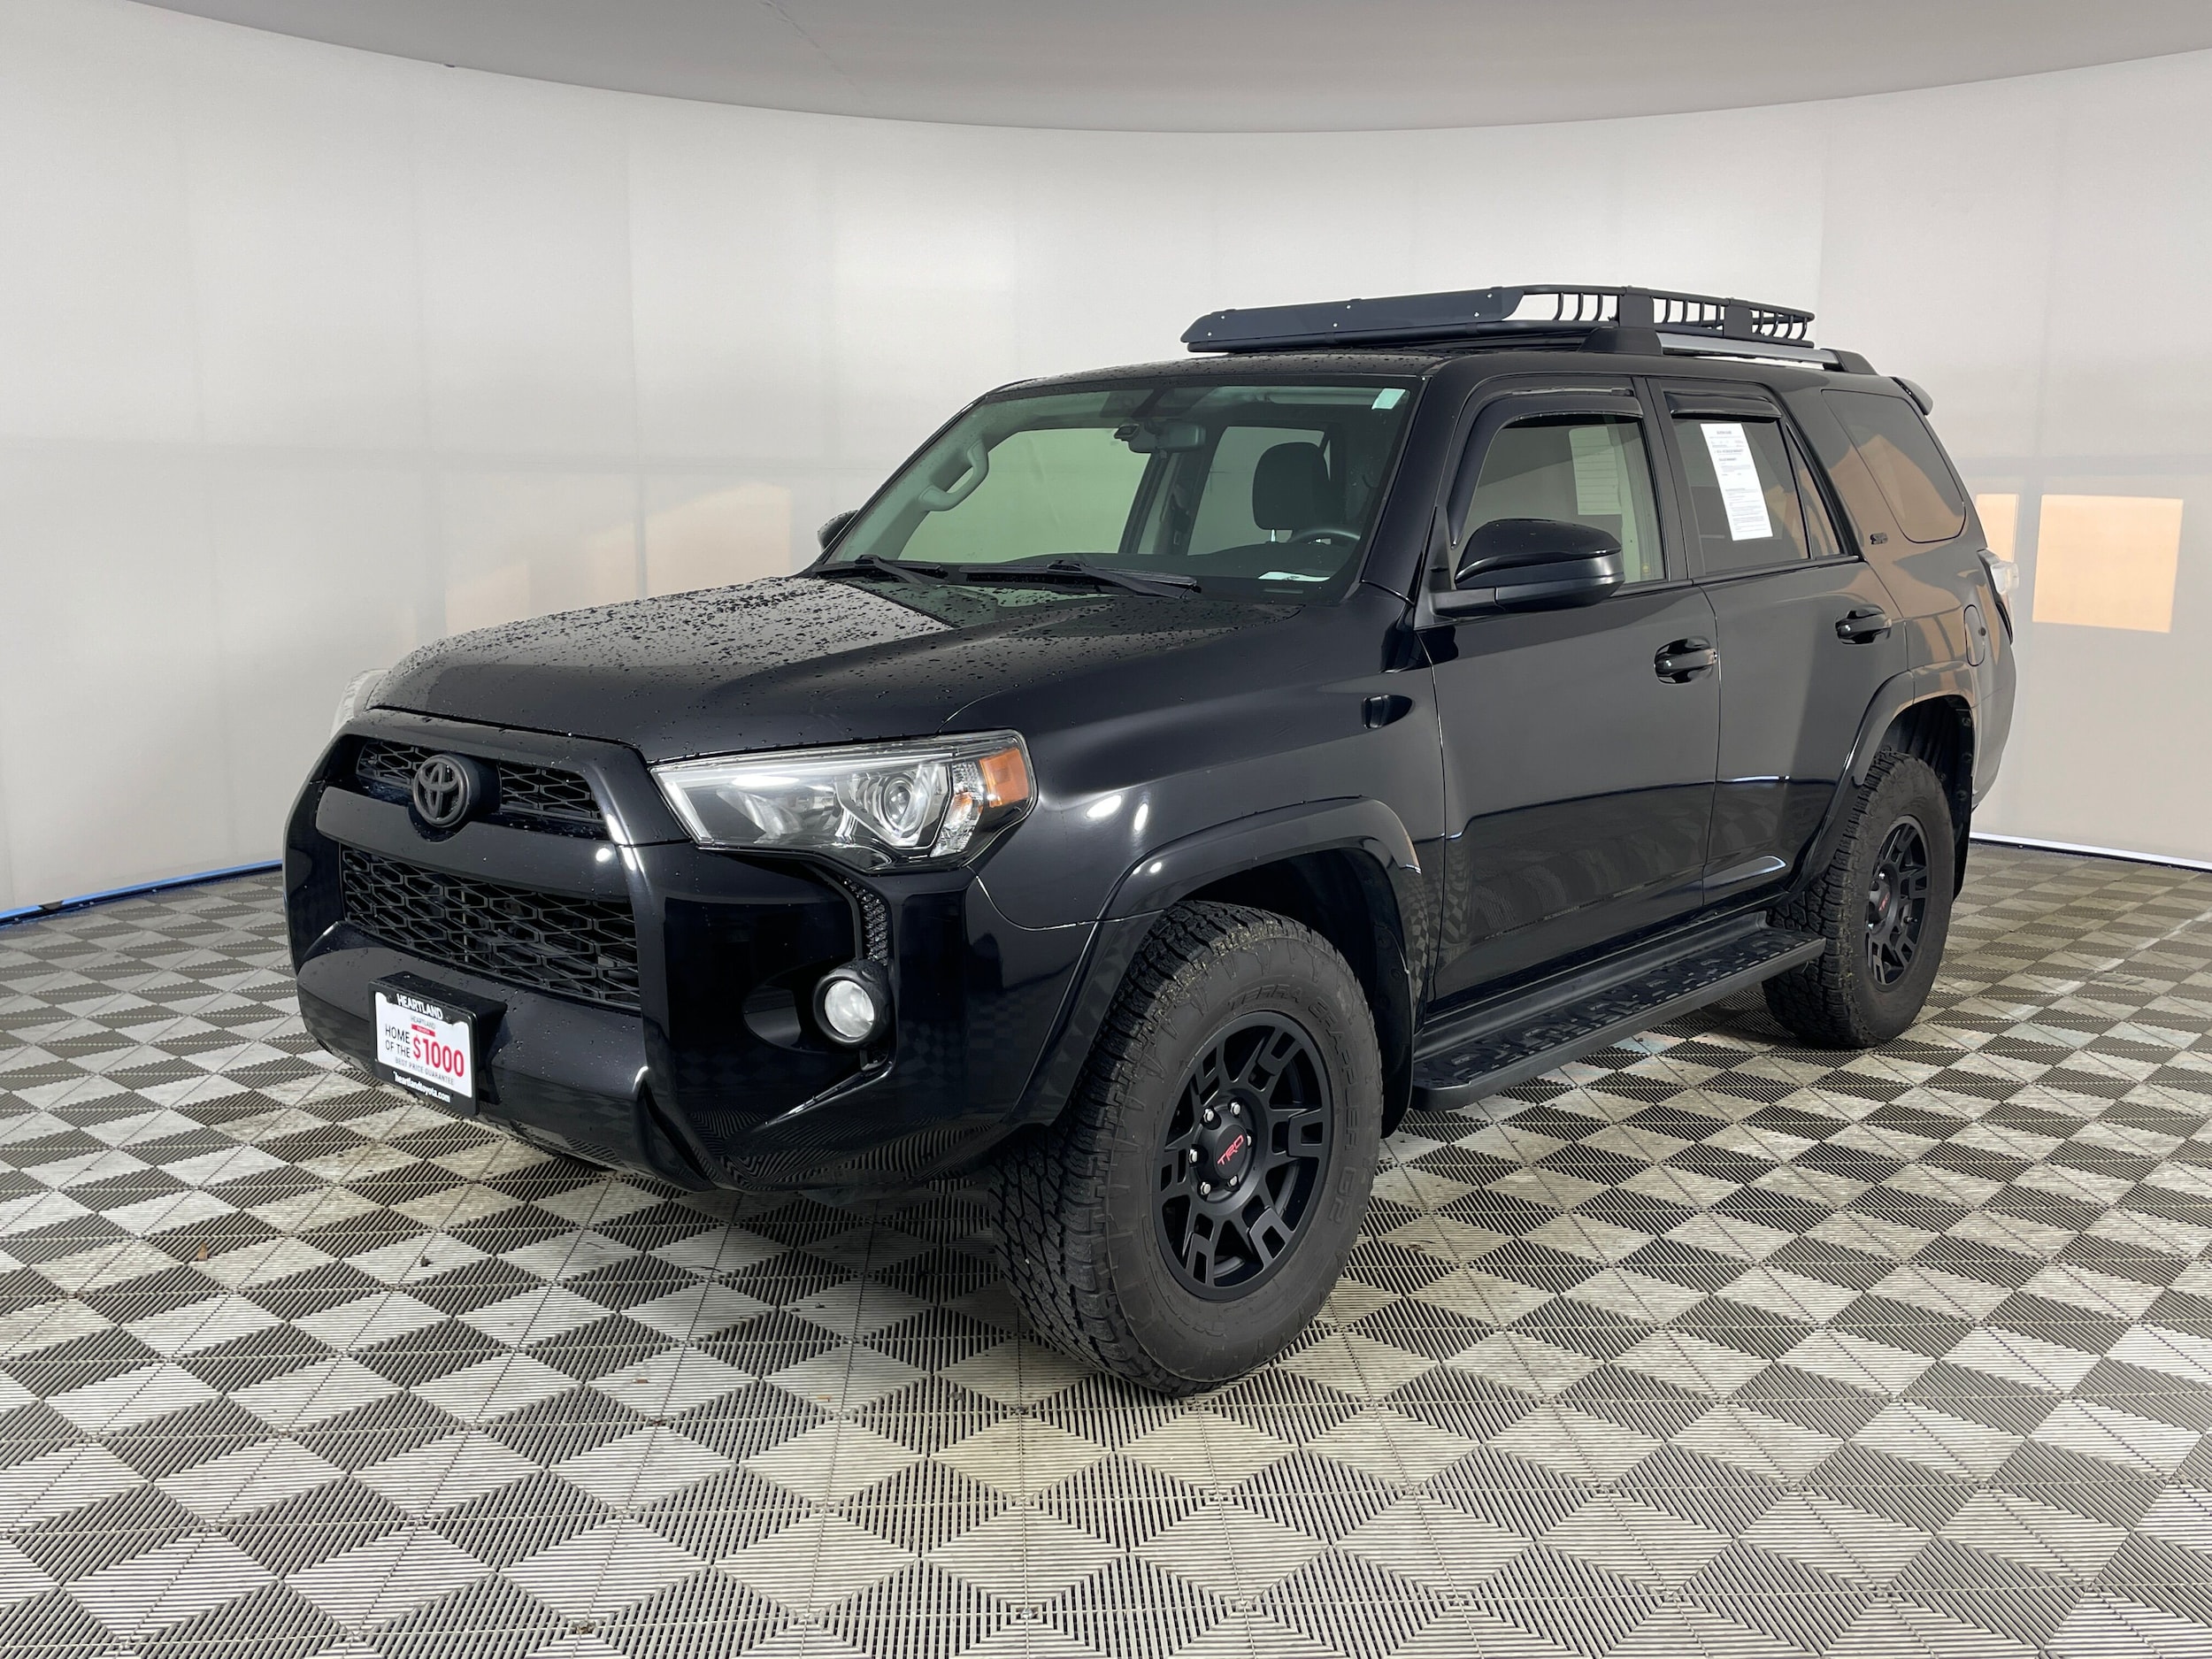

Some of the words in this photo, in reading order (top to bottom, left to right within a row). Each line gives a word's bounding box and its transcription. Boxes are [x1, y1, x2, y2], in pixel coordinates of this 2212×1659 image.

[396, 993, 443, 1020] HEARTLAND
[1227, 983, 1302, 1010] TERRA
[385, 1024, 411, 1044] HOME
[411, 1014, 436, 1029] HEARTLAND
[385, 1040, 395, 1051] OF
[396, 1044, 411, 1058] THE
[413, 1035, 465, 1078] $1000
[395, 1056, 407, 1067] BEST
[409, 1062, 424, 1073] PRICE
[425, 1067, 454, 1086] GUARANTEE
[1217, 1134, 1244, 1165] TRD
